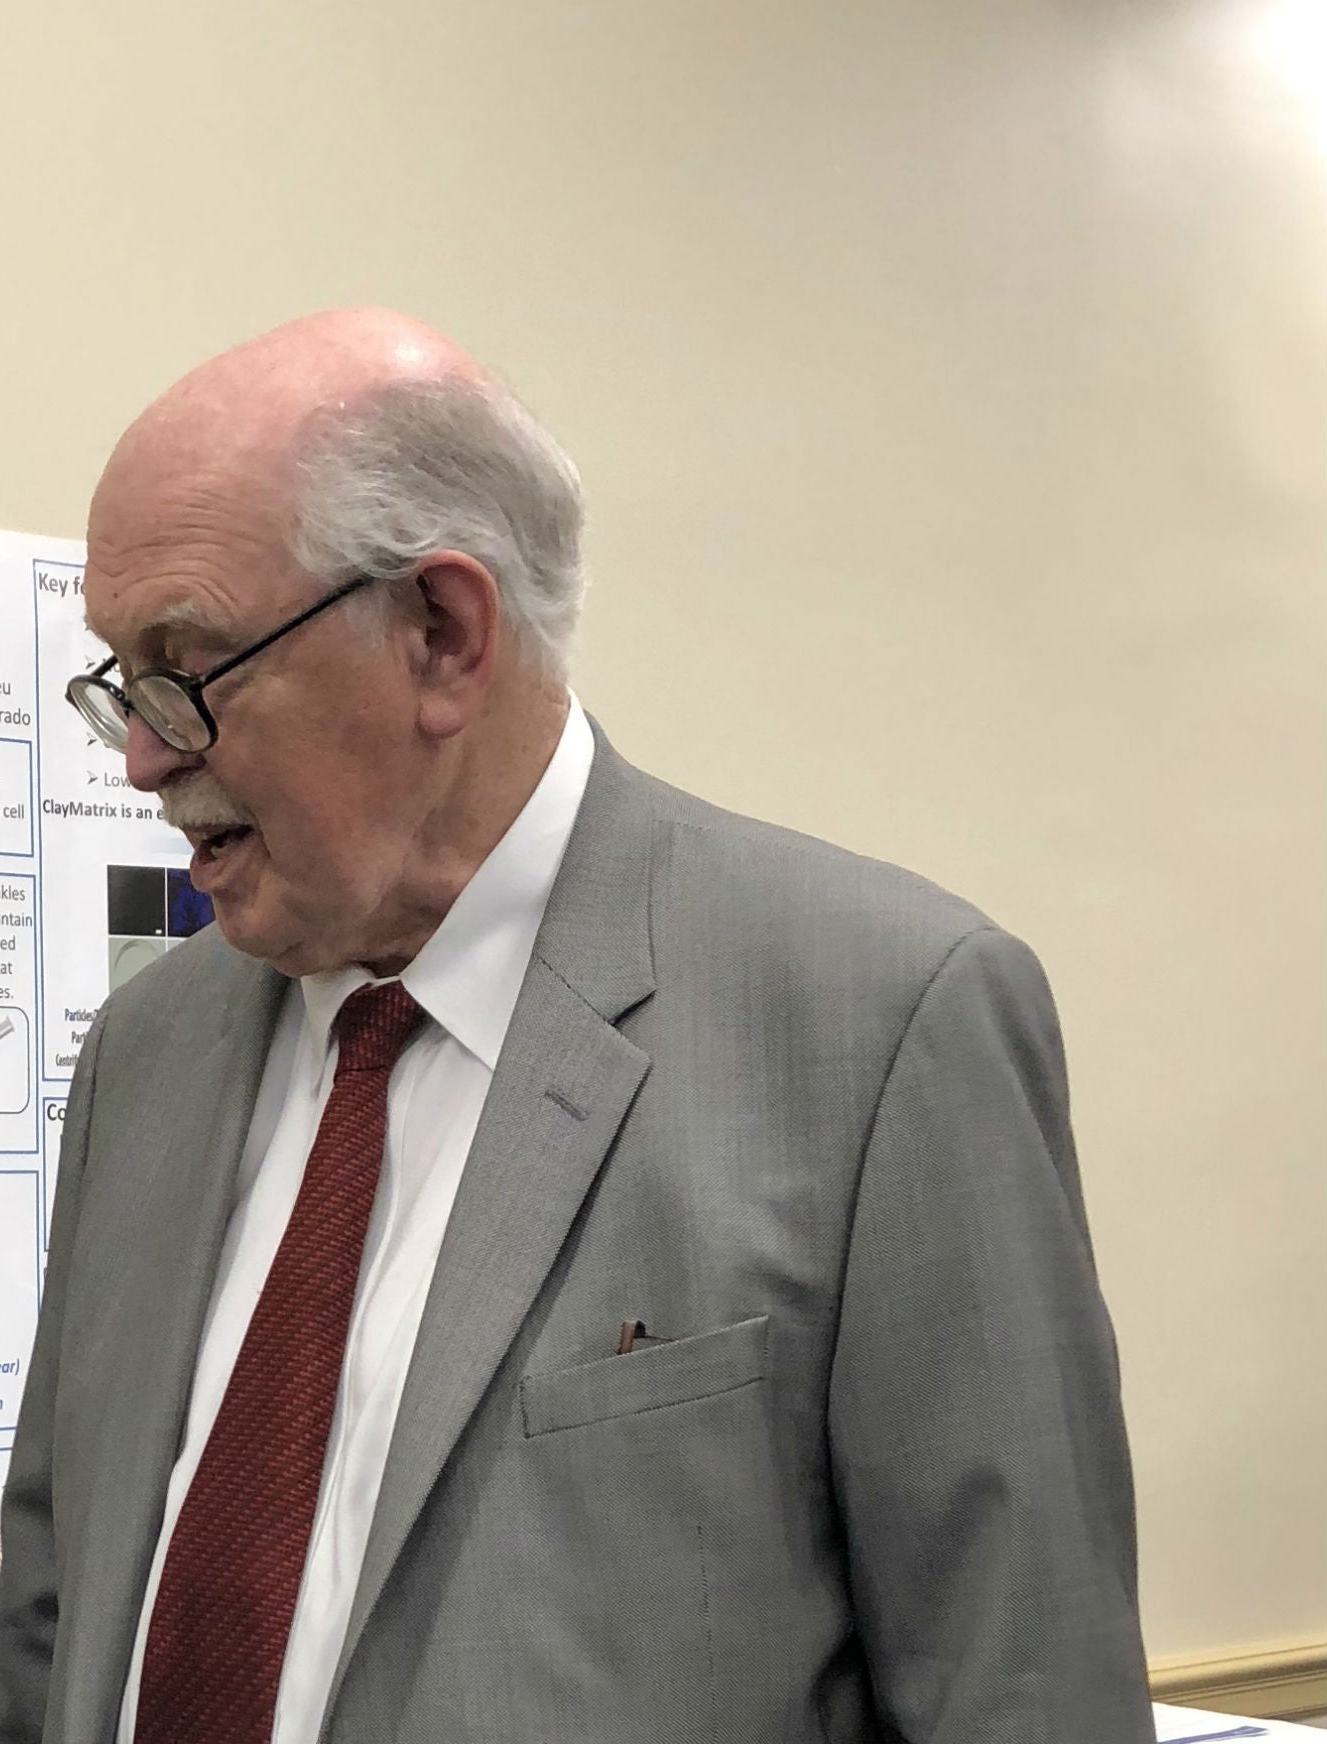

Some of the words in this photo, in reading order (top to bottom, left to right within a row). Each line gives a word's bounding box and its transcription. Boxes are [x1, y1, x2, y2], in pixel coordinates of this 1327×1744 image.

[38, 571, 68, 598] Key
[3, 804, 24, 820] cell
[42, 799, 117, 819] ClayMatrix
[121, 803, 132, 819] is
[135, 807, 153, 819] an
